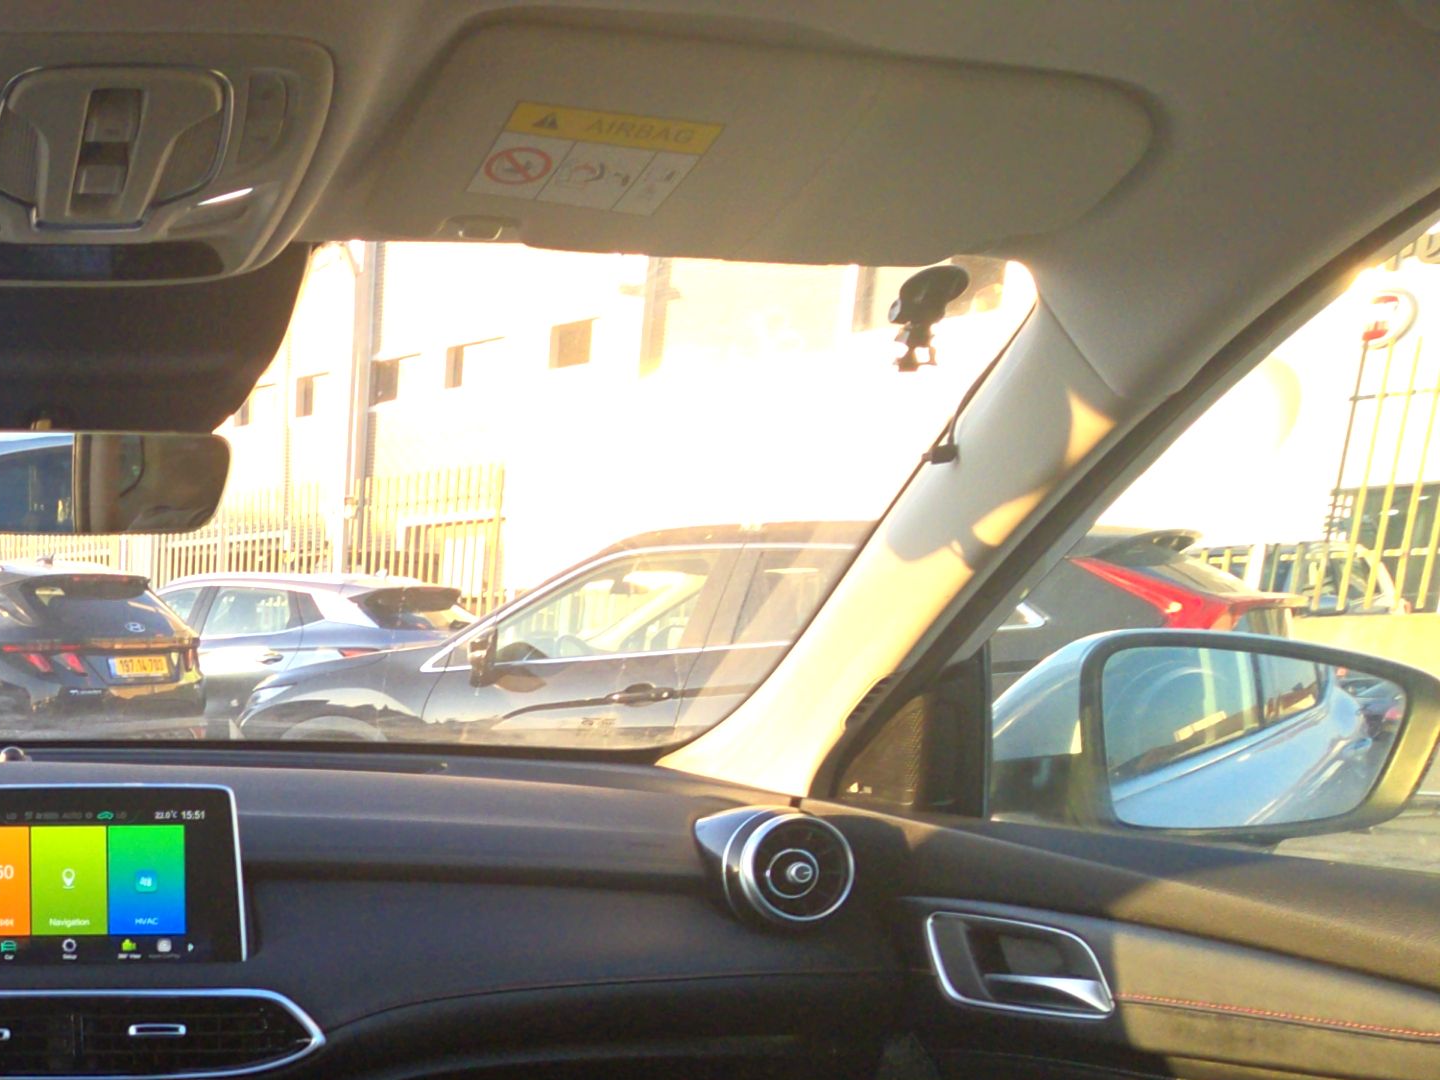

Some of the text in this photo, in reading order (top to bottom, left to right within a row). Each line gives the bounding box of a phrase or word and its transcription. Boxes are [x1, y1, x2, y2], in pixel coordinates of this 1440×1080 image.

[583, 117, 696, 145] AIRBAG
[181, 810, 206, 820] 15:51
[49, 917, 91, 928] Navigation
[134, 917, 159, 926] HVAC
